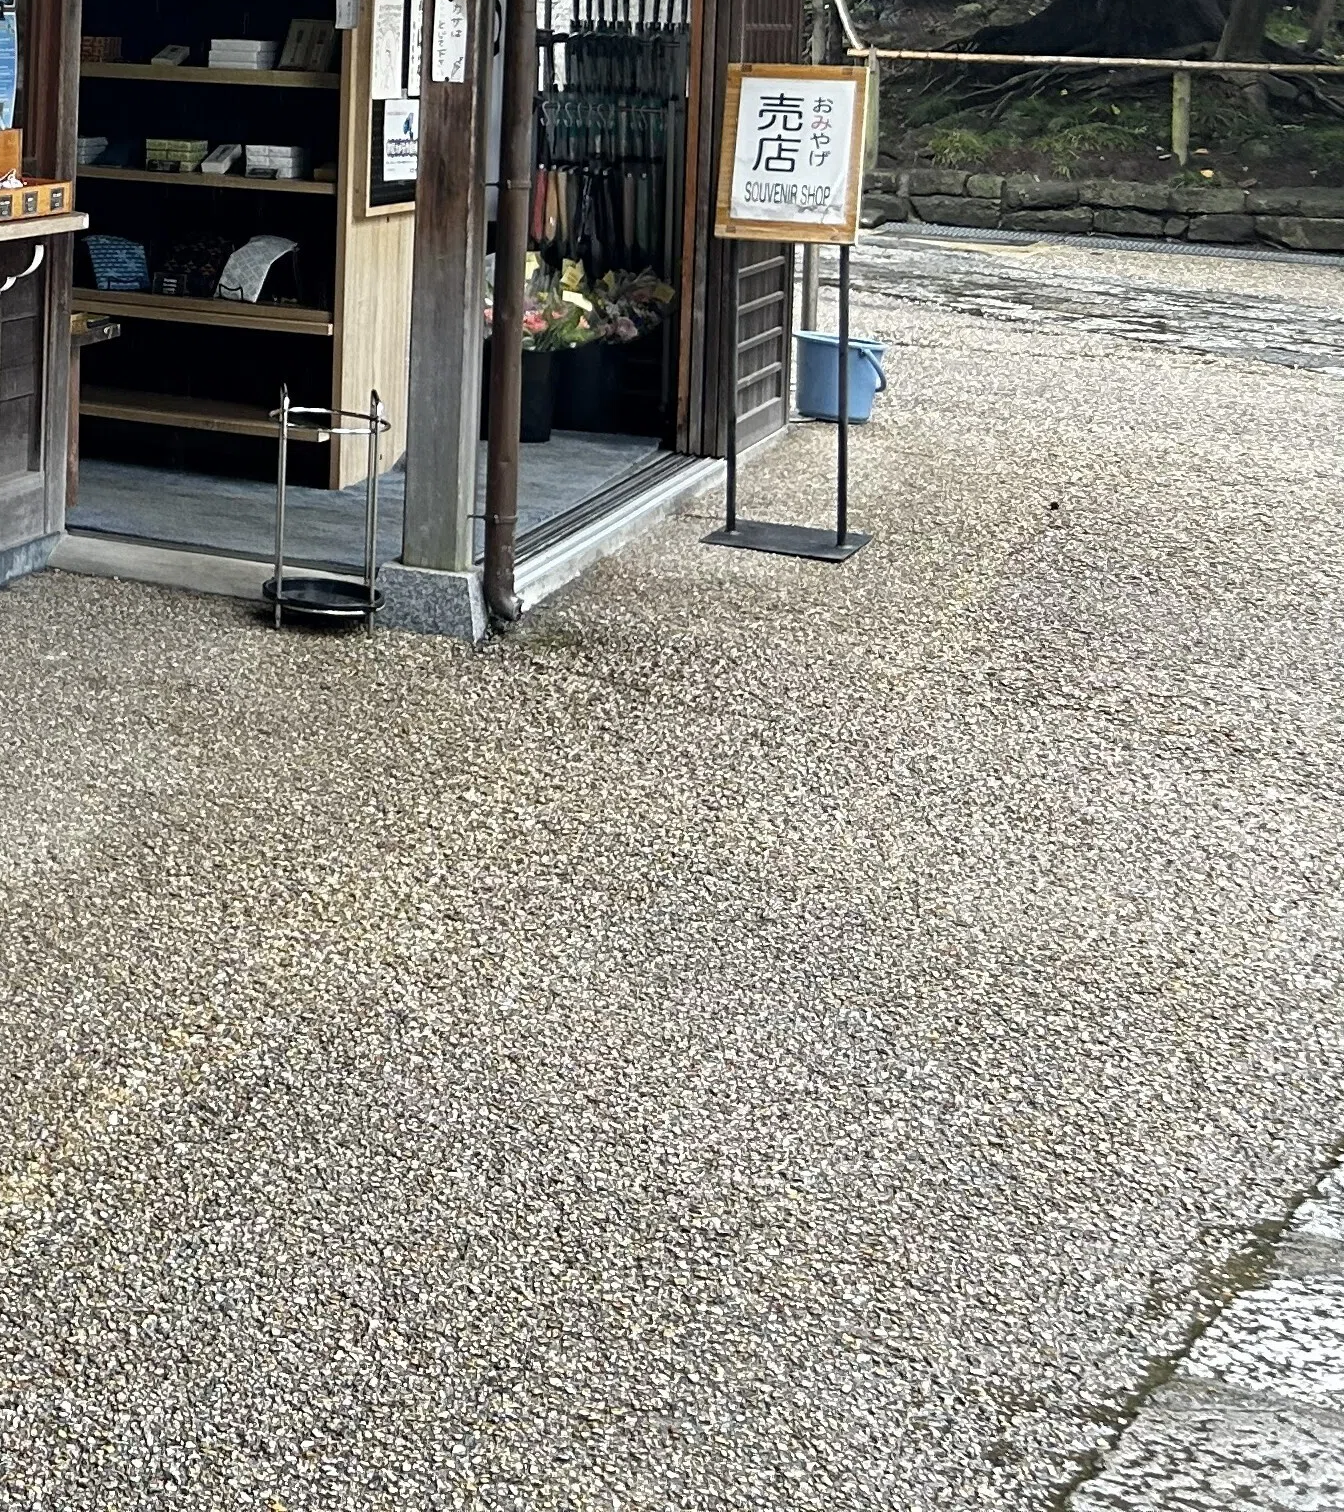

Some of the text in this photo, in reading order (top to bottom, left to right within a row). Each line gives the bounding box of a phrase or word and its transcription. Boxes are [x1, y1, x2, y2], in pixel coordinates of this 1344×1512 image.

[752, 93, 805, 173] 売店
[809, 96, 834, 167] おみやげ
[744, 181, 831, 206] SOUVENIR SHOP
